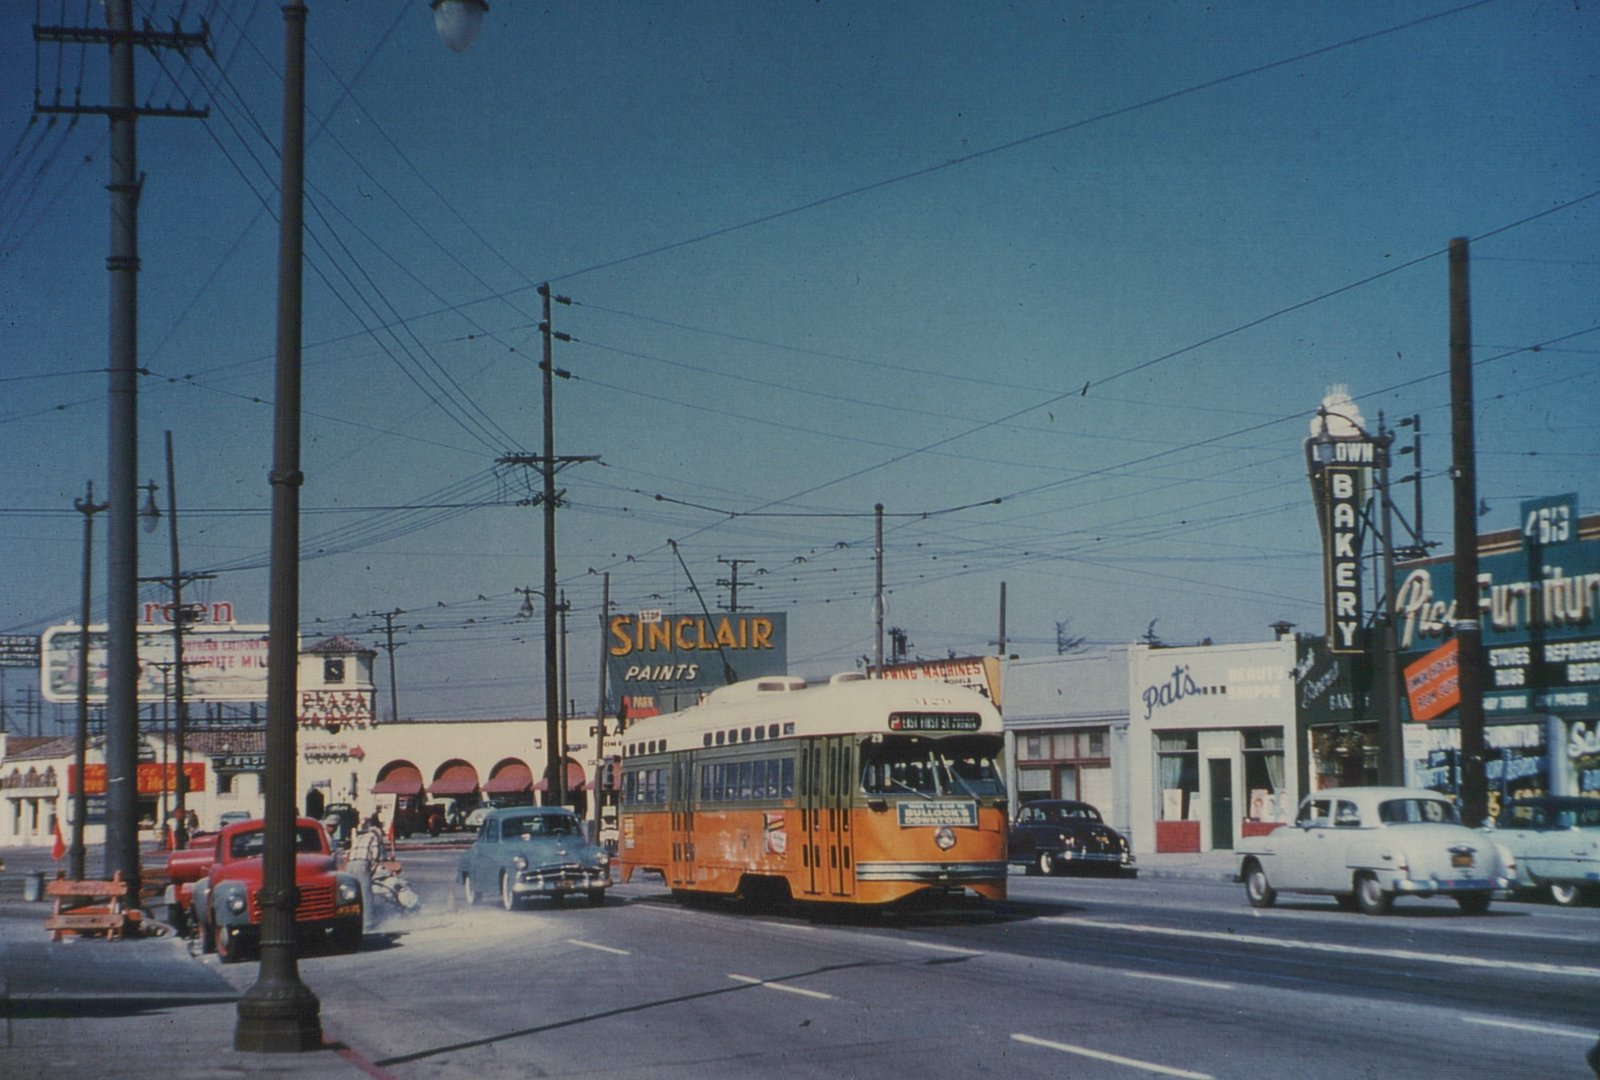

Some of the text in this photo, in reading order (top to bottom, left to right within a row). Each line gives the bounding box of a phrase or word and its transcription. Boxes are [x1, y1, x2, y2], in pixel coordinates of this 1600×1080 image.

[1332, 473, 1358, 647] BAKERY
[609, 614, 775, 657] SINCLAIR
[624, 664, 699, 681] PAINTS
[922, 661, 981, 679] MACHINES
